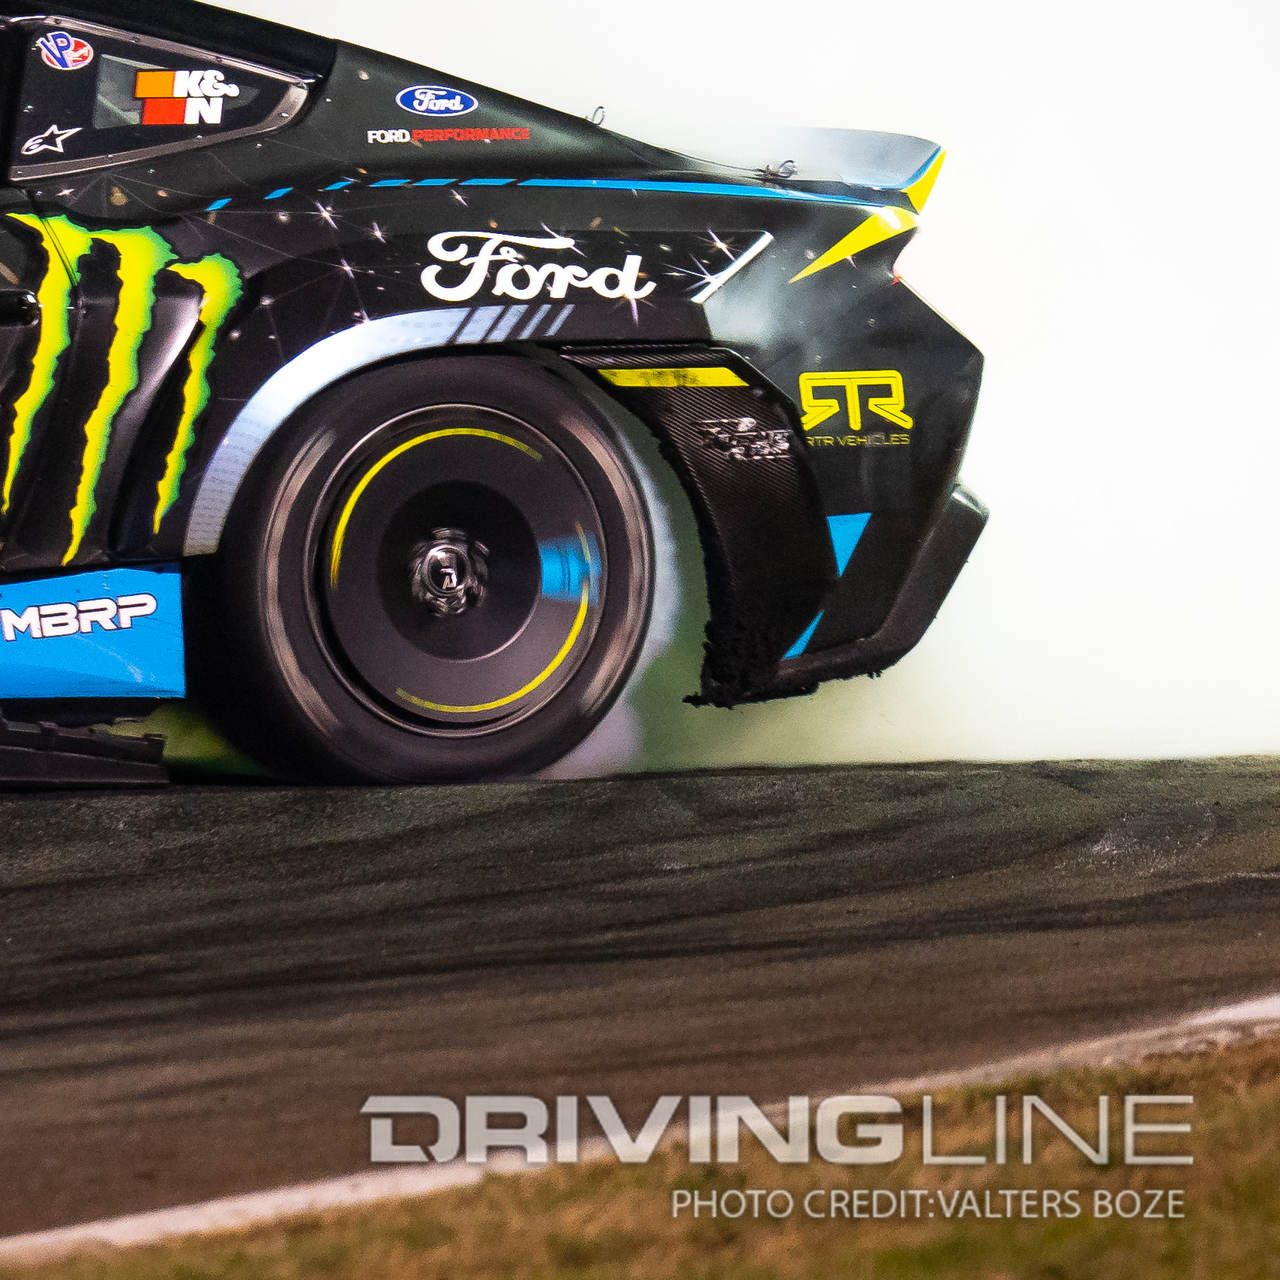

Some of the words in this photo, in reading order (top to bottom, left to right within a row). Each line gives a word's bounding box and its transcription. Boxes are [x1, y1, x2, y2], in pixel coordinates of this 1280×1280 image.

[413, 88, 465, 111] Ford
[367, 128, 411, 144] FORD
[411, 127, 530, 143] PERFORMANCE
[420, 231, 657, 302] Ford
[0, 592, 158, 642] MBRP
